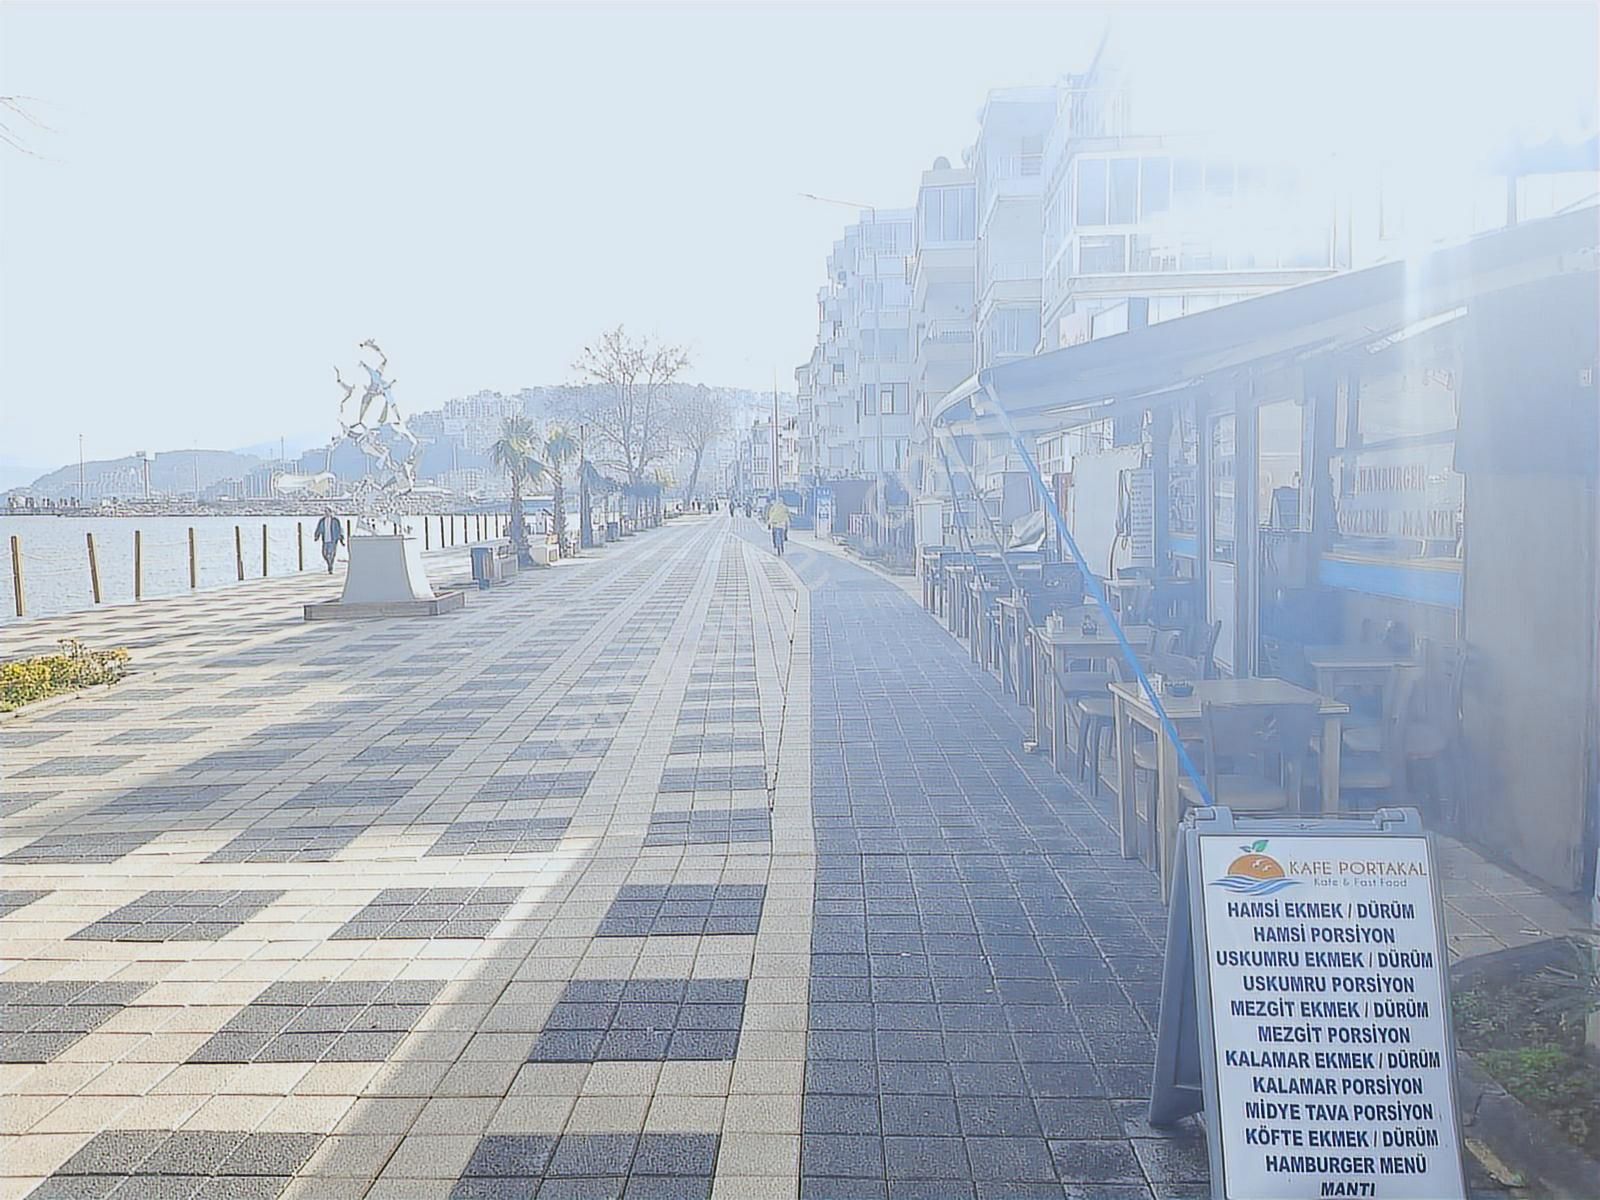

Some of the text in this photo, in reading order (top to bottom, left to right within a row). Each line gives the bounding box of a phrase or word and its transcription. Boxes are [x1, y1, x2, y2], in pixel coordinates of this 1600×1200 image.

[1289, 860, 1428, 877] KAFE PORTAKAL
[1379, 877, 1408, 888] Food
[1227, 898, 1416, 920] HAMSİ EKMEK / DÜRÜM
[1253, 923, 1396, 944] HAMSİ PORSİYON
[1216, 949, 1434, 969] USKUMRU EKMEK / DÜRÜM
[1242, 973, 1415, 993] USKUMRU PORSİYON
[1230, 997, 1429, 1019] MEZGİT EKMEK / DÜRÜM
[1257, 1022, 1411, 1044] MEZGİT PORSİYON
[1225, 1049, 1441, 1069] KALAMAR EKMEK / DÜRÜM
[1252, 1074, 1424, 1095] KALAMAR PORSİYON
[1245, 1098, 1434, 1121] MİDYE TAVA PORSİYON
[1245, 1124, 1439, 1148] KÖFTE EKMEK / DÜRÜM
[1265, 1154, 1427, 1174] HAMBURGER MENÜ
[1320, 1182, 1376, 1197] MANTI
